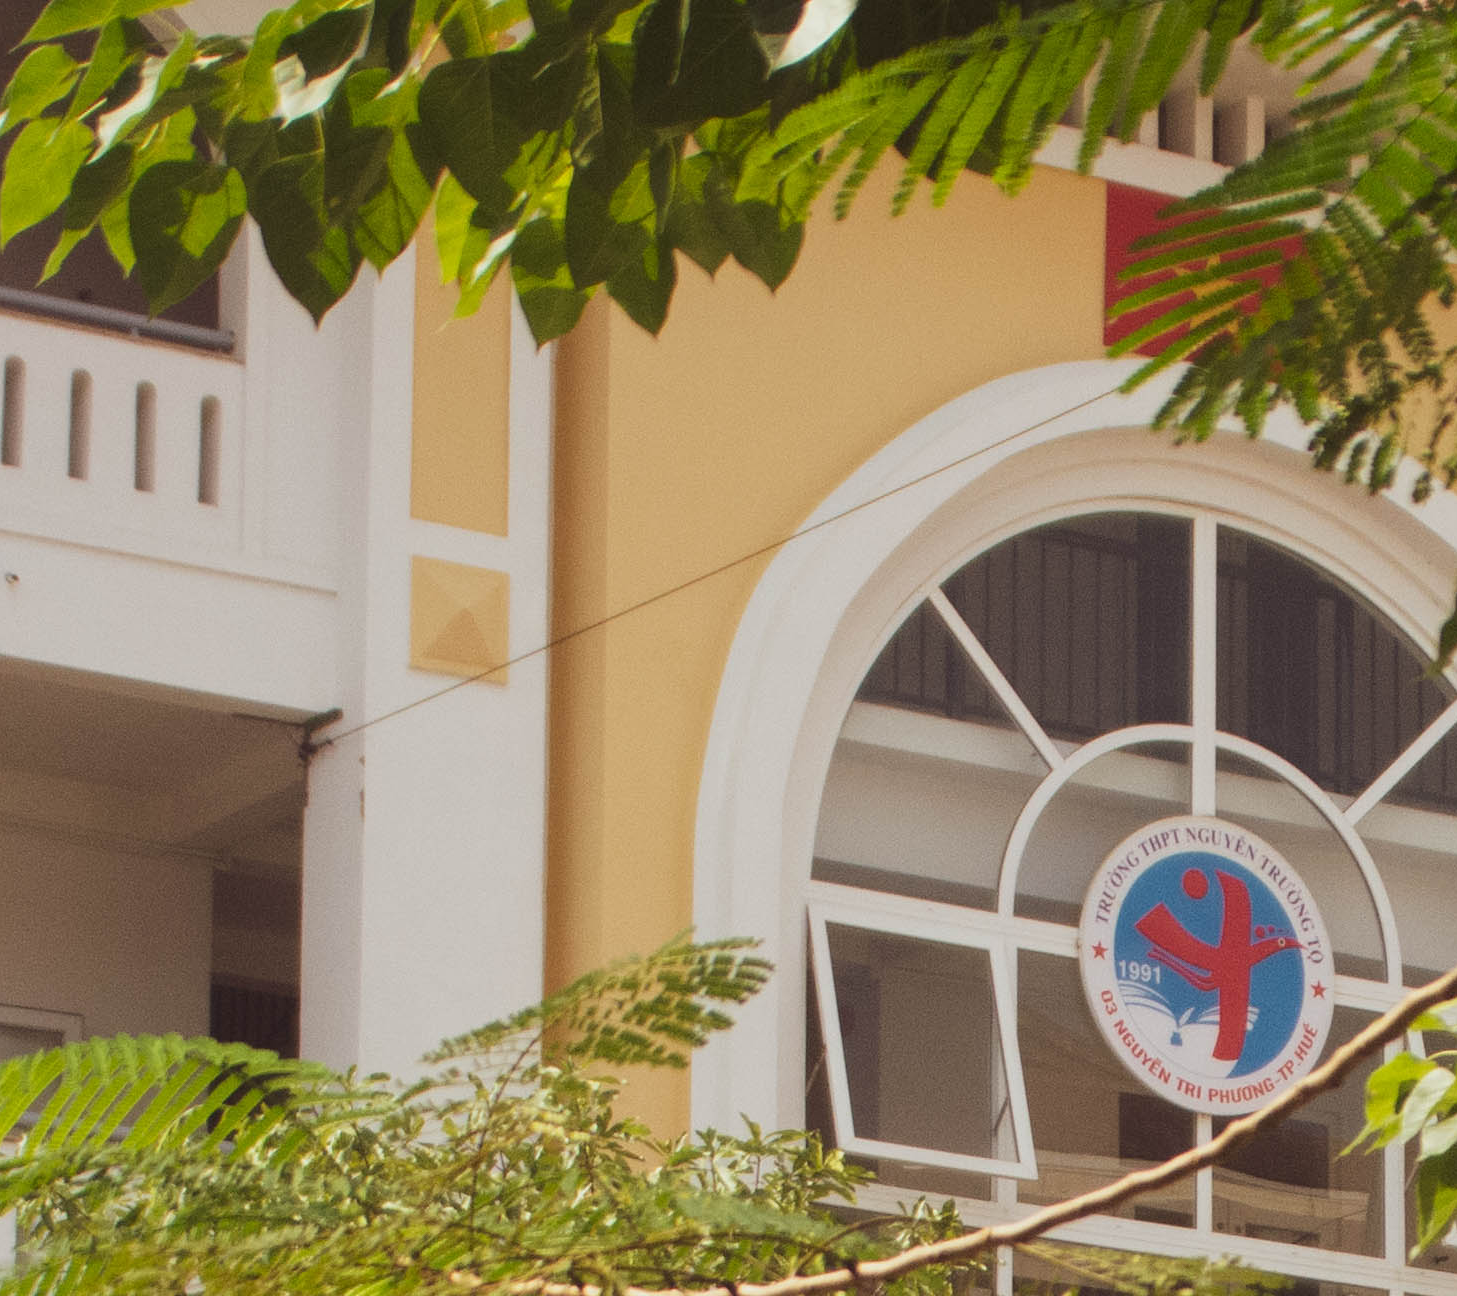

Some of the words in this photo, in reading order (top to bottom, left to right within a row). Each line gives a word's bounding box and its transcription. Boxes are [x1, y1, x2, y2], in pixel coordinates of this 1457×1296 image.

[1095, 850, 1140, 924] TRƯỜNG
[1138, 828, 1181, 857] THPT
[1184, 827, 1257, 861] NGUYỄN
[1260, 854, 1315, 932] TRƯỜNG
[1307, 935, 1325, 965] TỘ
[1118, 960, 1161, 984] 1991
[1100, 989, 1118, 1016] 03
[1113, 1018, 1172, 1085] NGUYỄN
[1176, 1077, 1202, 1100] TRI
